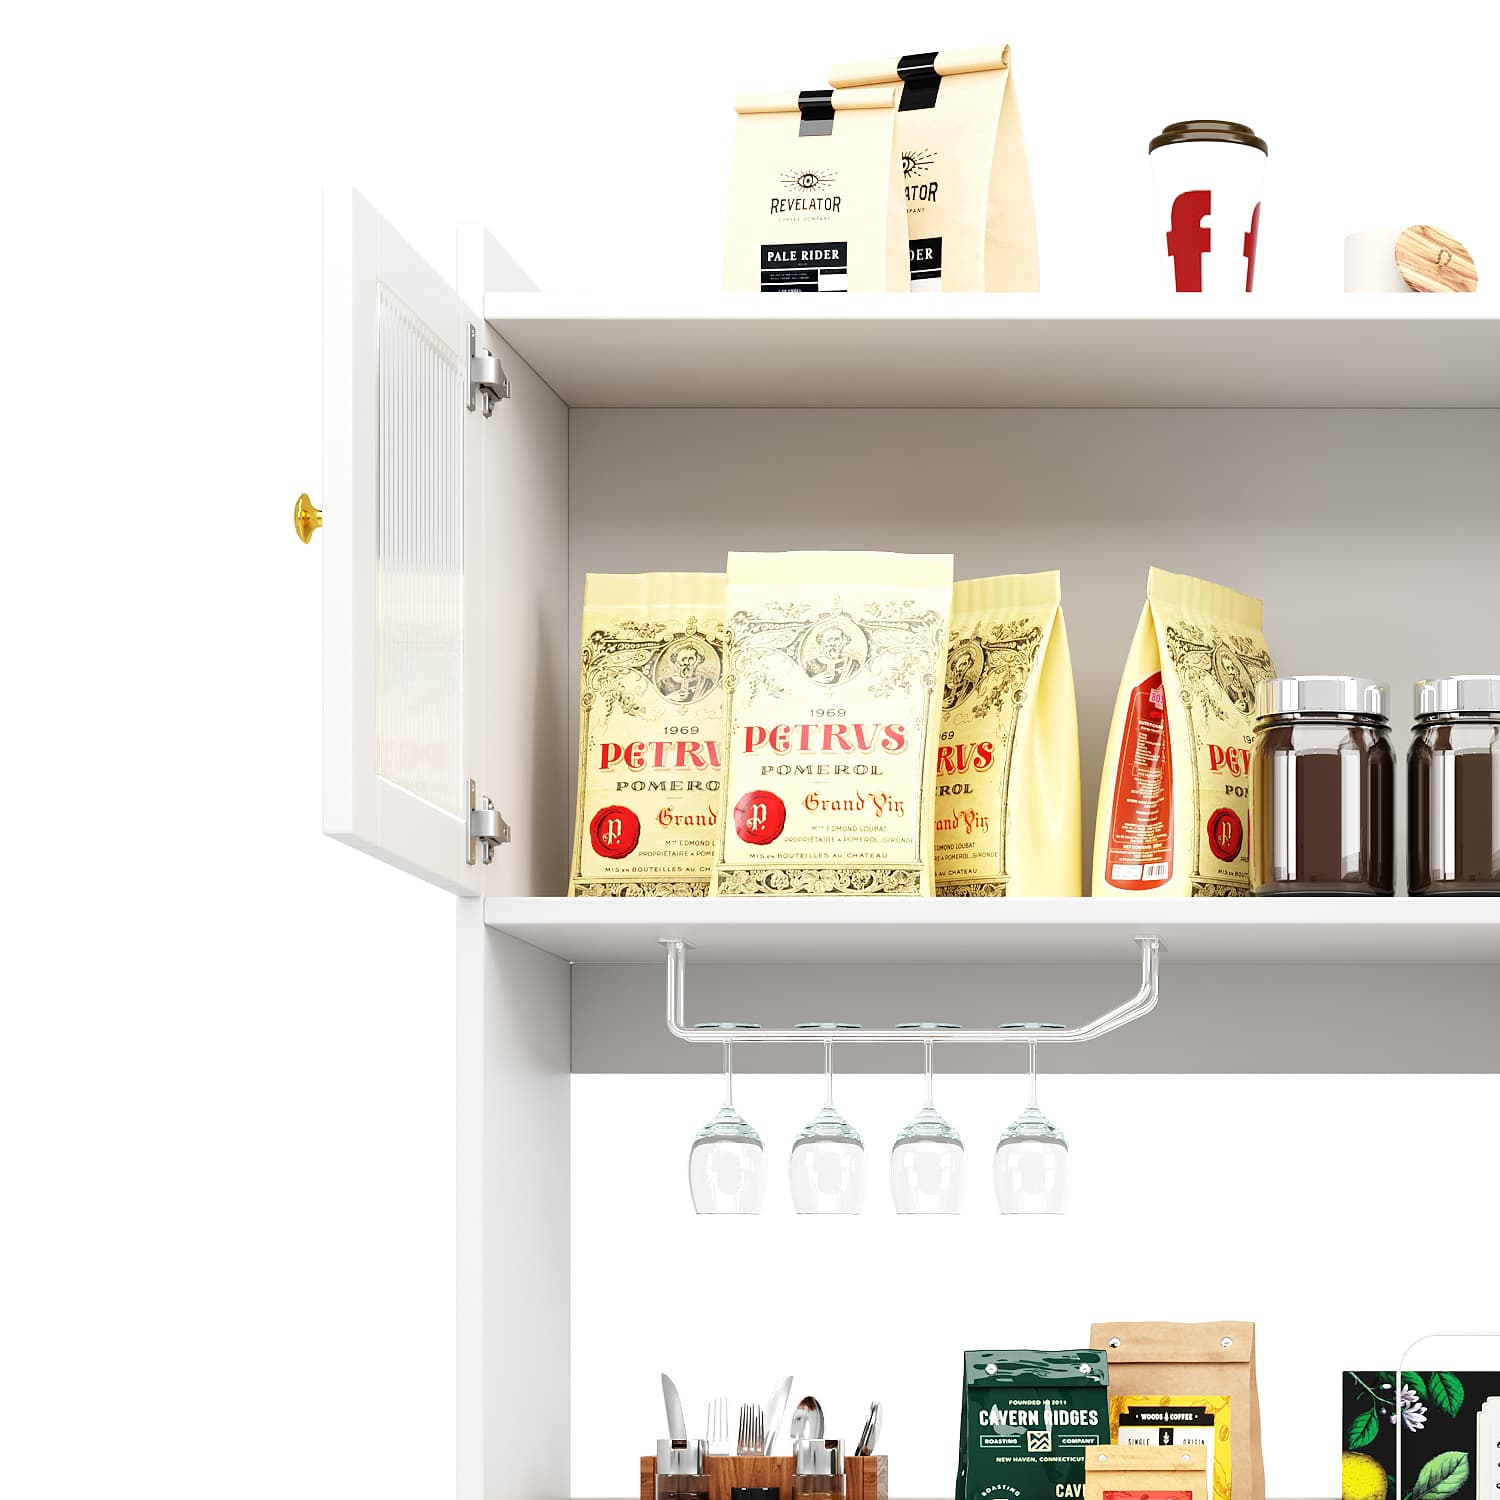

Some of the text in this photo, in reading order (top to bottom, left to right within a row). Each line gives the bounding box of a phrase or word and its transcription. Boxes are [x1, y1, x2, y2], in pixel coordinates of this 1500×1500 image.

[770, 196, 841, 215] REVELATOR
[767, 249, 840, 262] PALE RIDER
[810, 708, 847, 718] 1969
[664, 726, 700, 735] 1969
[939, 731, 955, 741] 69
[742, 723, 906, 754] PETRVS
[599, 740, 721, 771] PETRV
[937, 742, 993, 774] RVS
[1207, 744, 1250, 775] PET
[760, 764, 884, 776] POMEROL
[616, 780, 720, 792] POMERO
[802, 788, 864, 814] Grand
[656, 802, 717, 829] Grand
[935, 808, 959, 831] and
[679, 839, 710, 847] EDMOND
[955, 842, 976, 850] LOUBAT
[979, 1409, 1099, 1426] CAVERN RIDGES
[1140, 1413, 1193, 1421] WOODS COFFEE
[1128, 1438, 1205, 1446] SINGLE ORIGIN
[981, 1484, 1021, 1497] ROASTING
[1056, 1483, 1086, 1498] CAV
